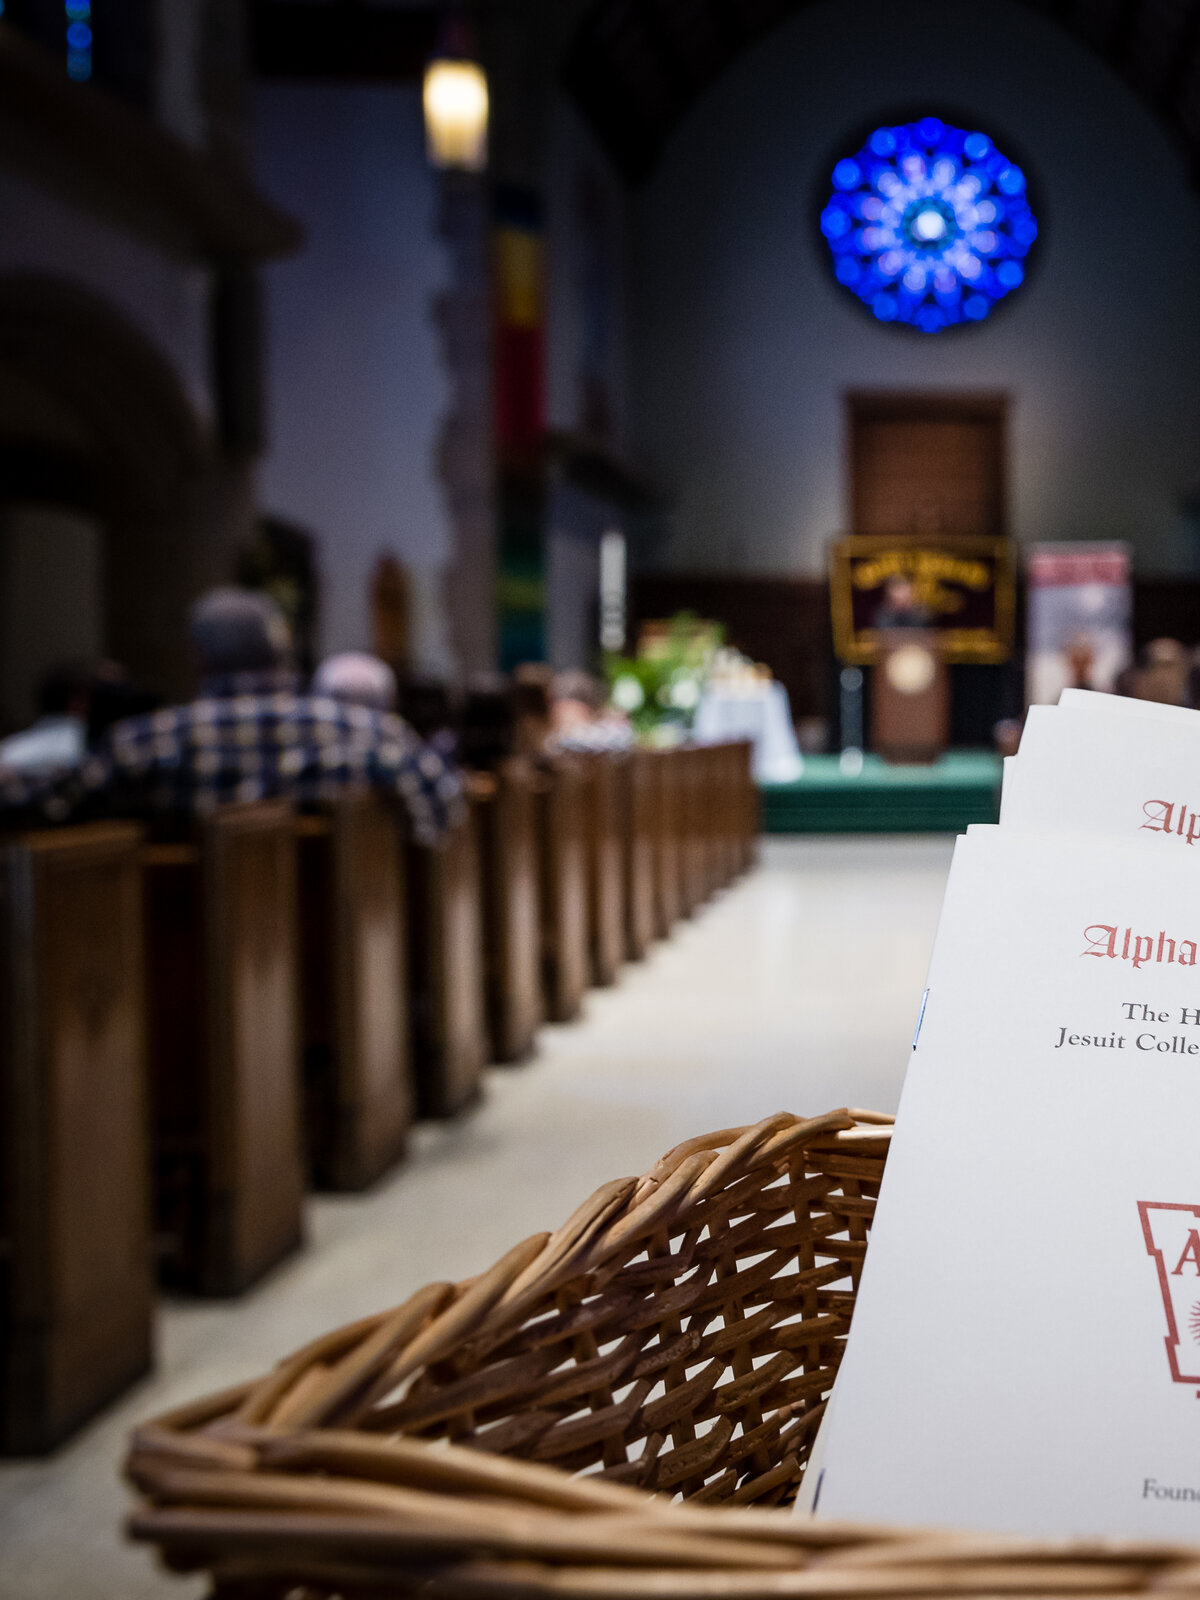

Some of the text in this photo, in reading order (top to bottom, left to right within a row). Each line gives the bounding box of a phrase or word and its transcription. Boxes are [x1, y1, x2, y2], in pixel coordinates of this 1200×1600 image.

[1081, 923, 1198, 970] Alpha
[1121, 1001, 1171, 1024] The
[1053, 1026, 1127, 1050] Jesuit
